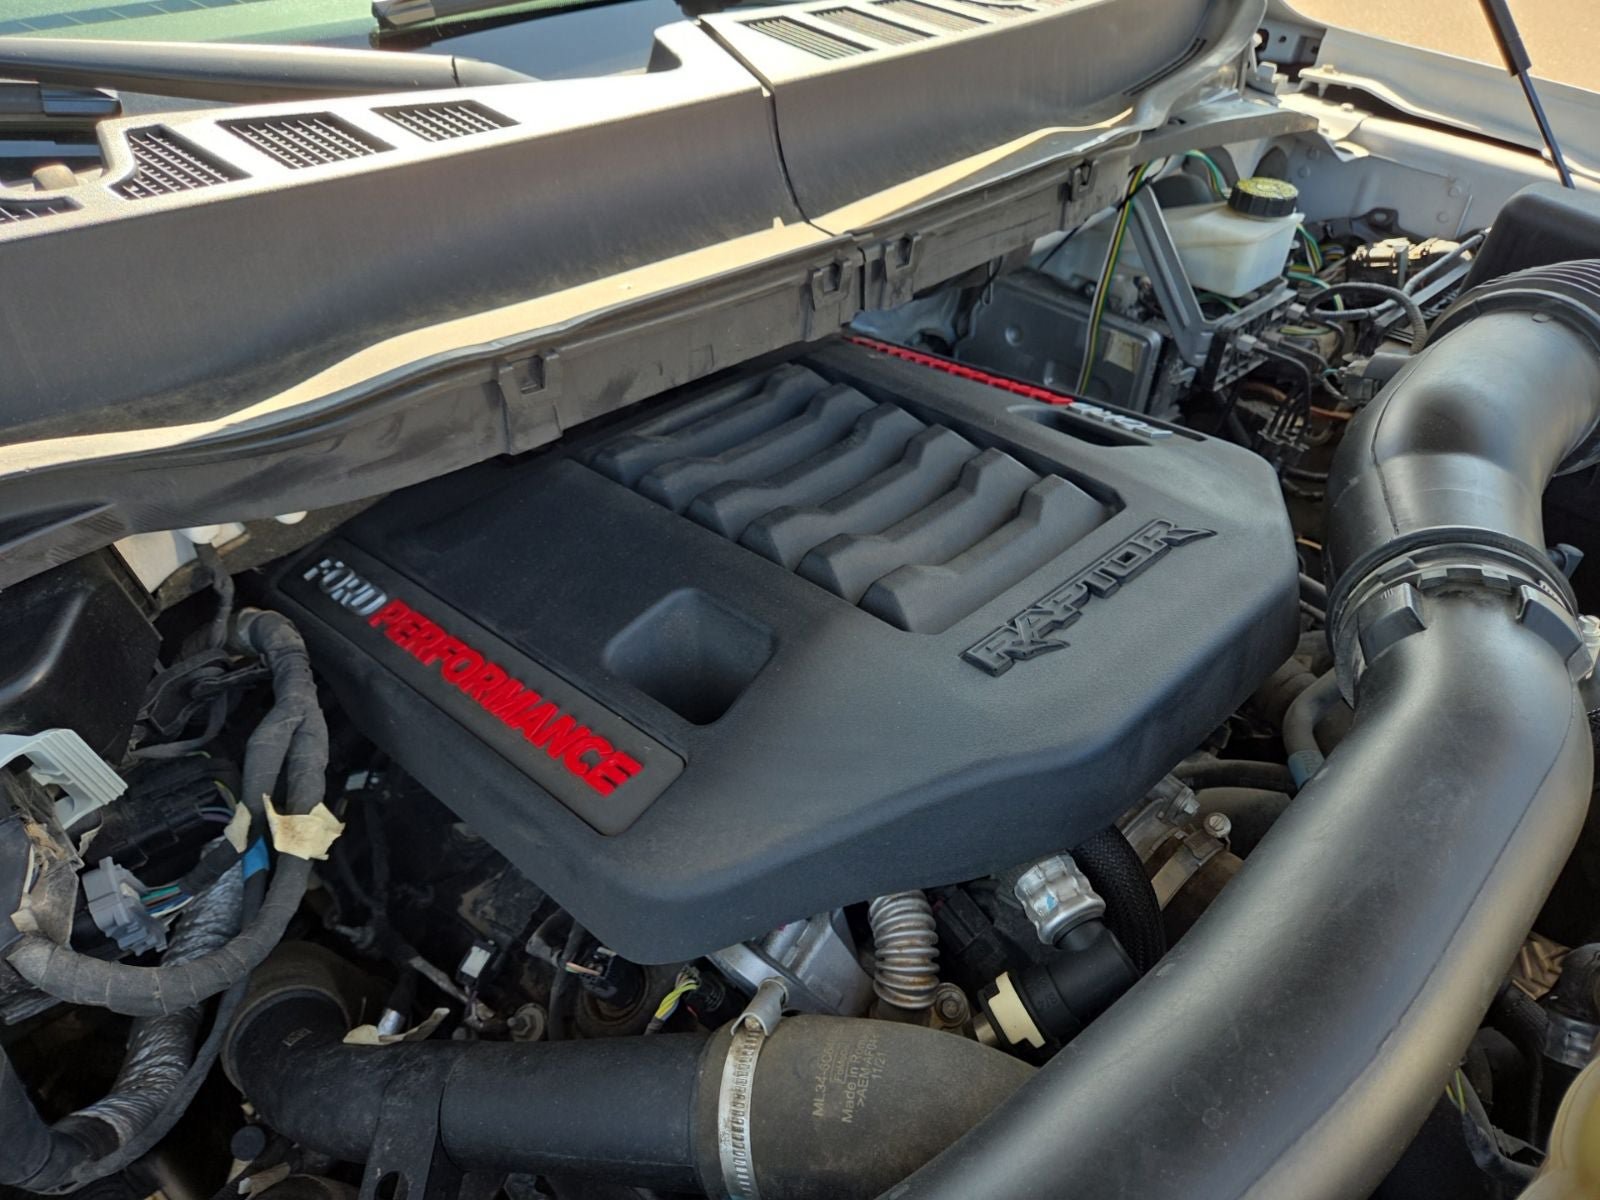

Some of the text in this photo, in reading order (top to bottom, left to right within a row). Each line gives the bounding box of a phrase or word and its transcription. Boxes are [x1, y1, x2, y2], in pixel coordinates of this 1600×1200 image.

[303, 558, 644, 798] FORD PERFORMANCE
[958, 518, 1218, 678] RAPTOR
[841, 1083, 856, 1123] Made
[850, 1066, 858, 1078] in
